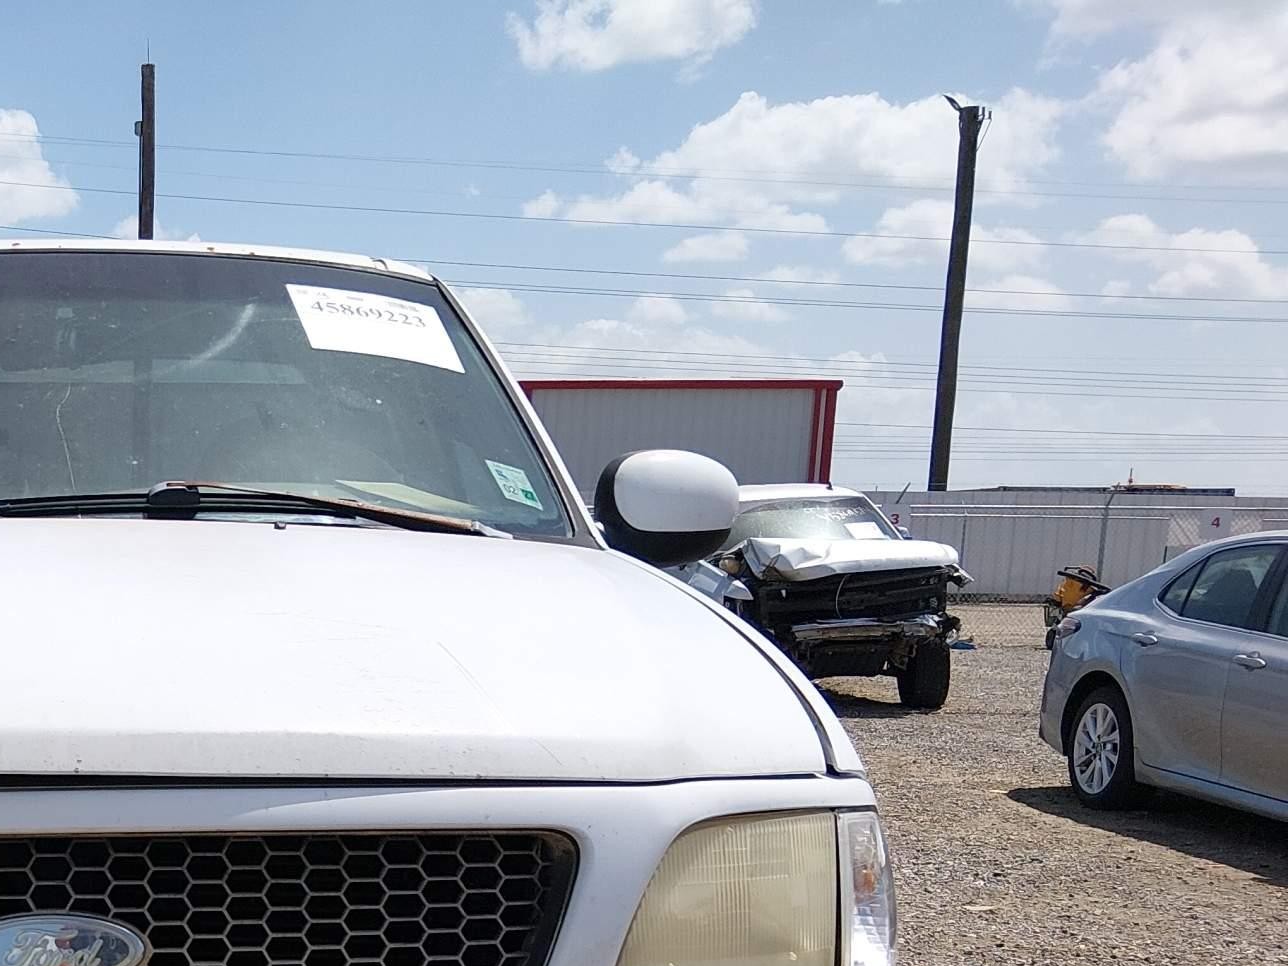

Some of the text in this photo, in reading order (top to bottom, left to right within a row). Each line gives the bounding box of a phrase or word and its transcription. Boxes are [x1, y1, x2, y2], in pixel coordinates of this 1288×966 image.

[311, 300, 427, 328] 45869223
[891, 513, 900, 525] 3
[1211, 516, 1220, 528] 4
